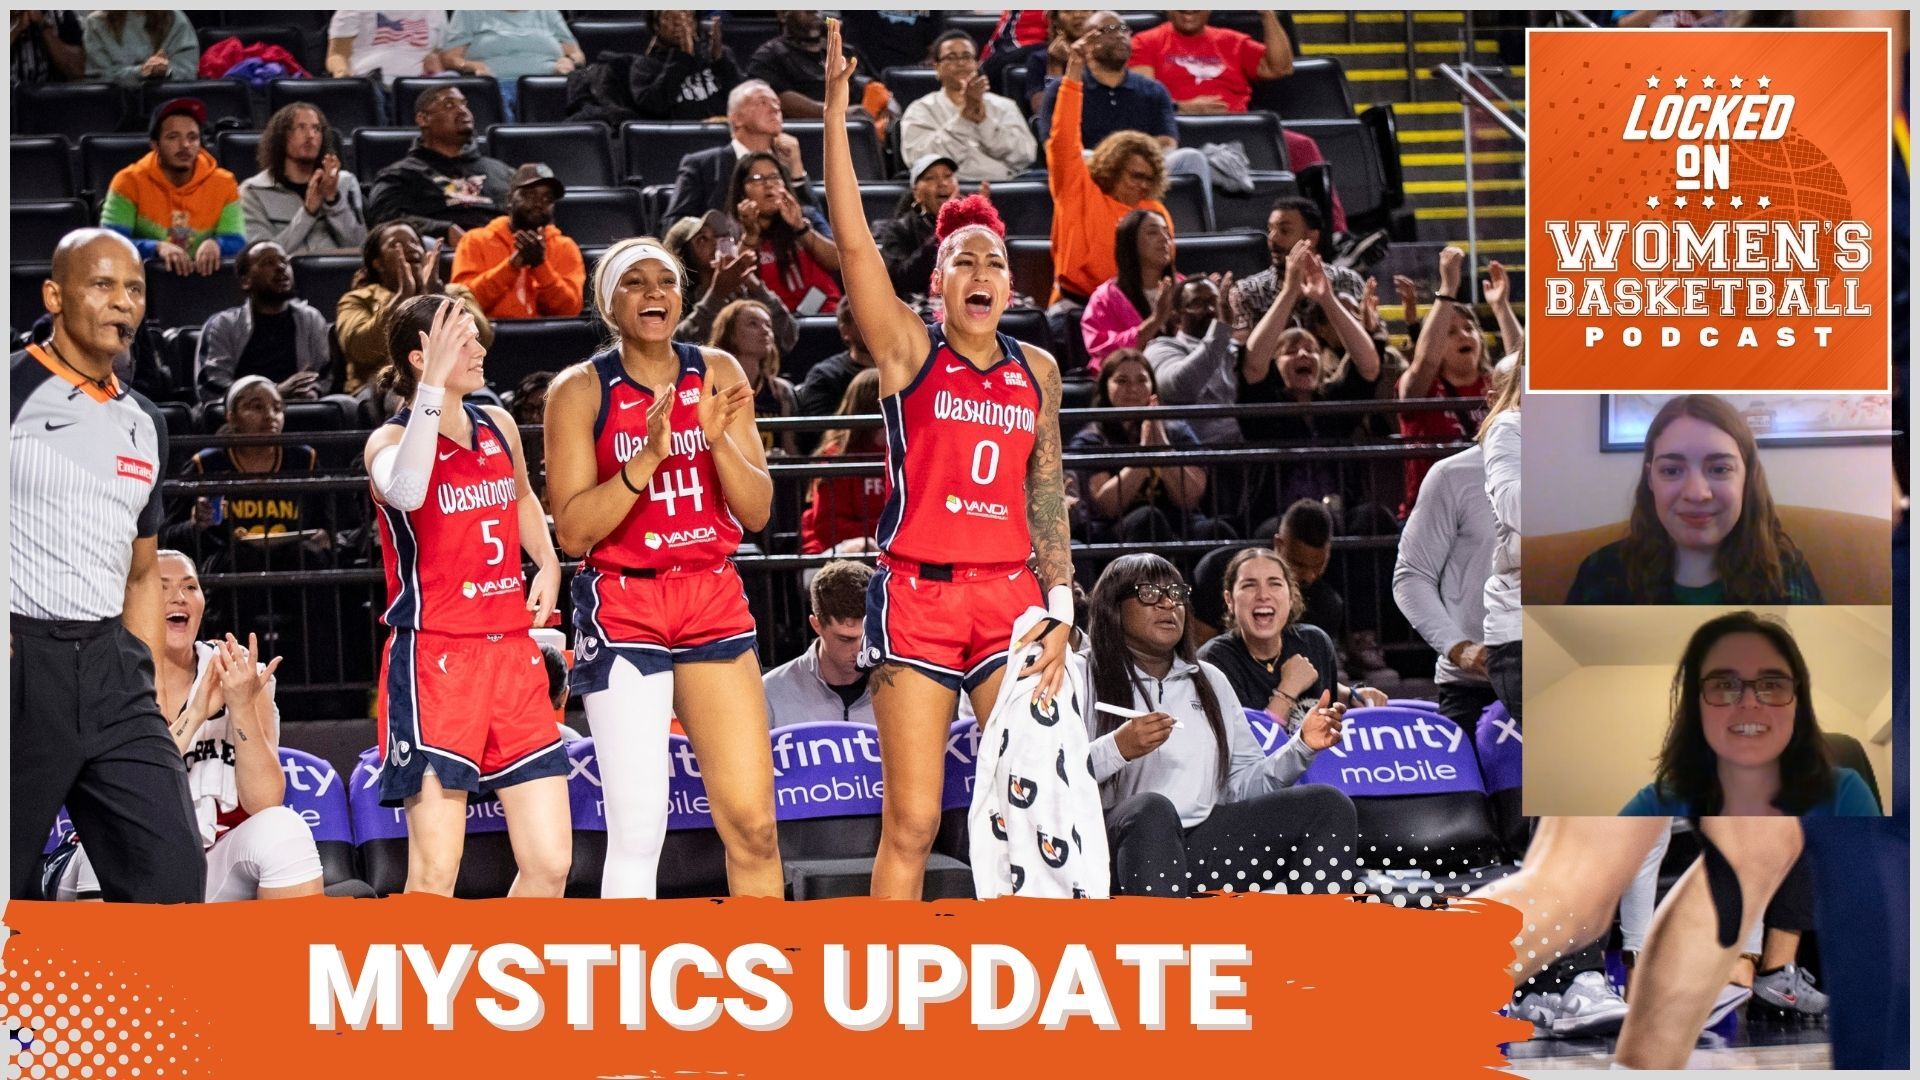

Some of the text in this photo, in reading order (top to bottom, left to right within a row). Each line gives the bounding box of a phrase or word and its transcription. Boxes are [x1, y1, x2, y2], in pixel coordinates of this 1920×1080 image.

[933, 389, 1036, 435] Washington
[970, 439, 1000, 486] 0
[648, 467, 704, 517] 44
[480, 519, 505, 566] 5
[661, 525, 717, 544] VANDA
[773, 730, 882, 777] finit
[1341, 760, 1458, 784] mobile
